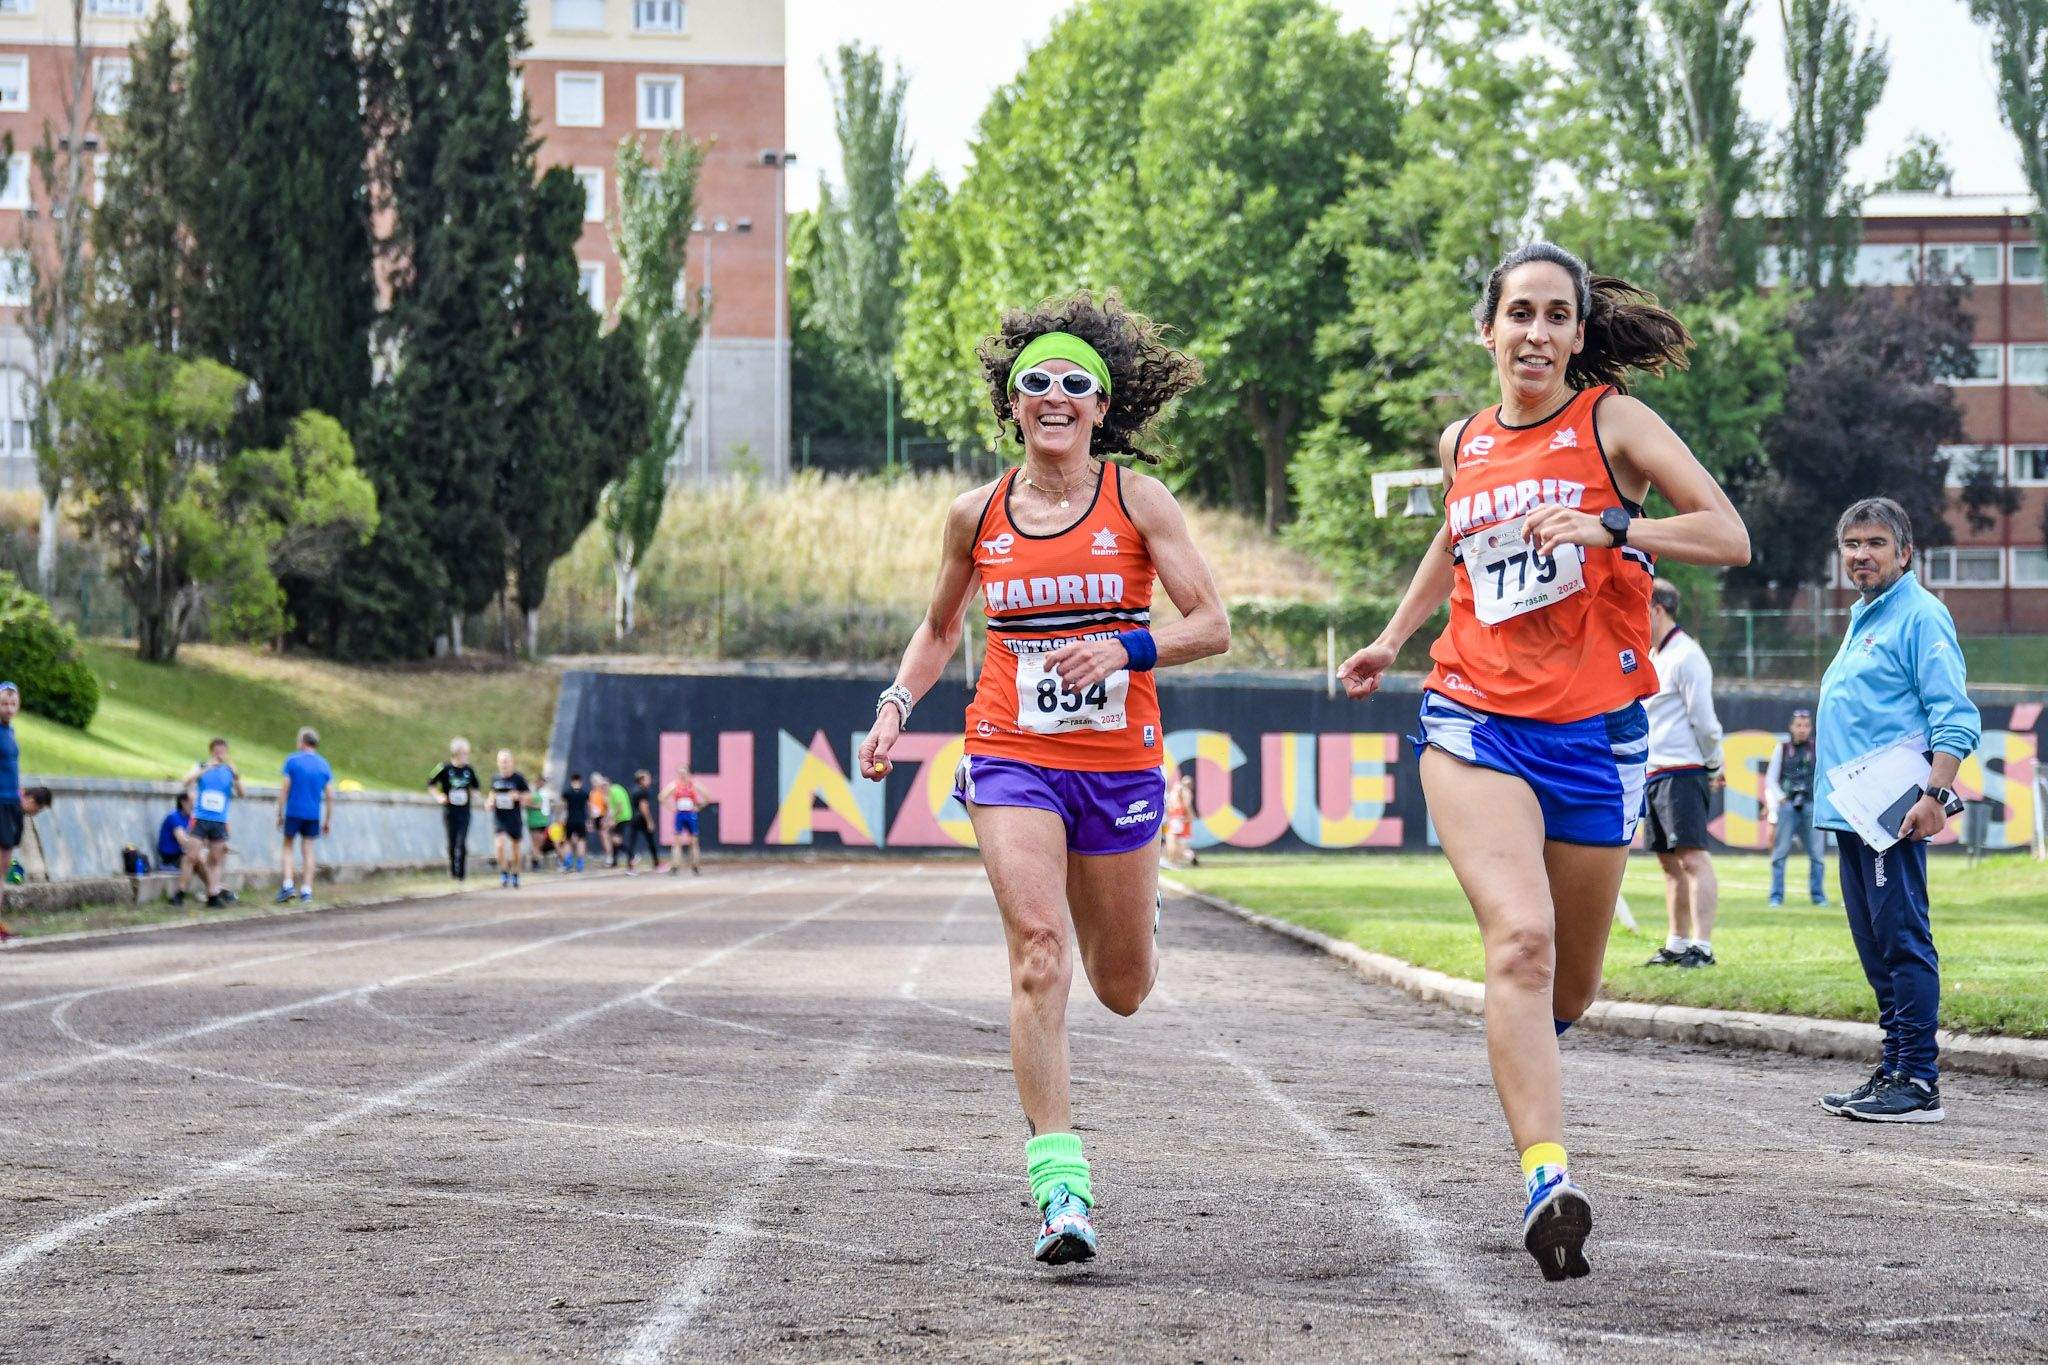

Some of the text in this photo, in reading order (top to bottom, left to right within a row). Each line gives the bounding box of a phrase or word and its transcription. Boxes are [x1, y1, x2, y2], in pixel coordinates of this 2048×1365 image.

[1449, 478, 1587, 537] MADRID
[1485, 548, 1557, 601] 779
[1557, 580, 1579, 595] 2023
[986, 573, 1124, 612] MADRID
[1036, 678, 1108, 713] 854
[1100, 713, 1121, 724] 2023
[1115, 810, 1157, 827] KARHU
